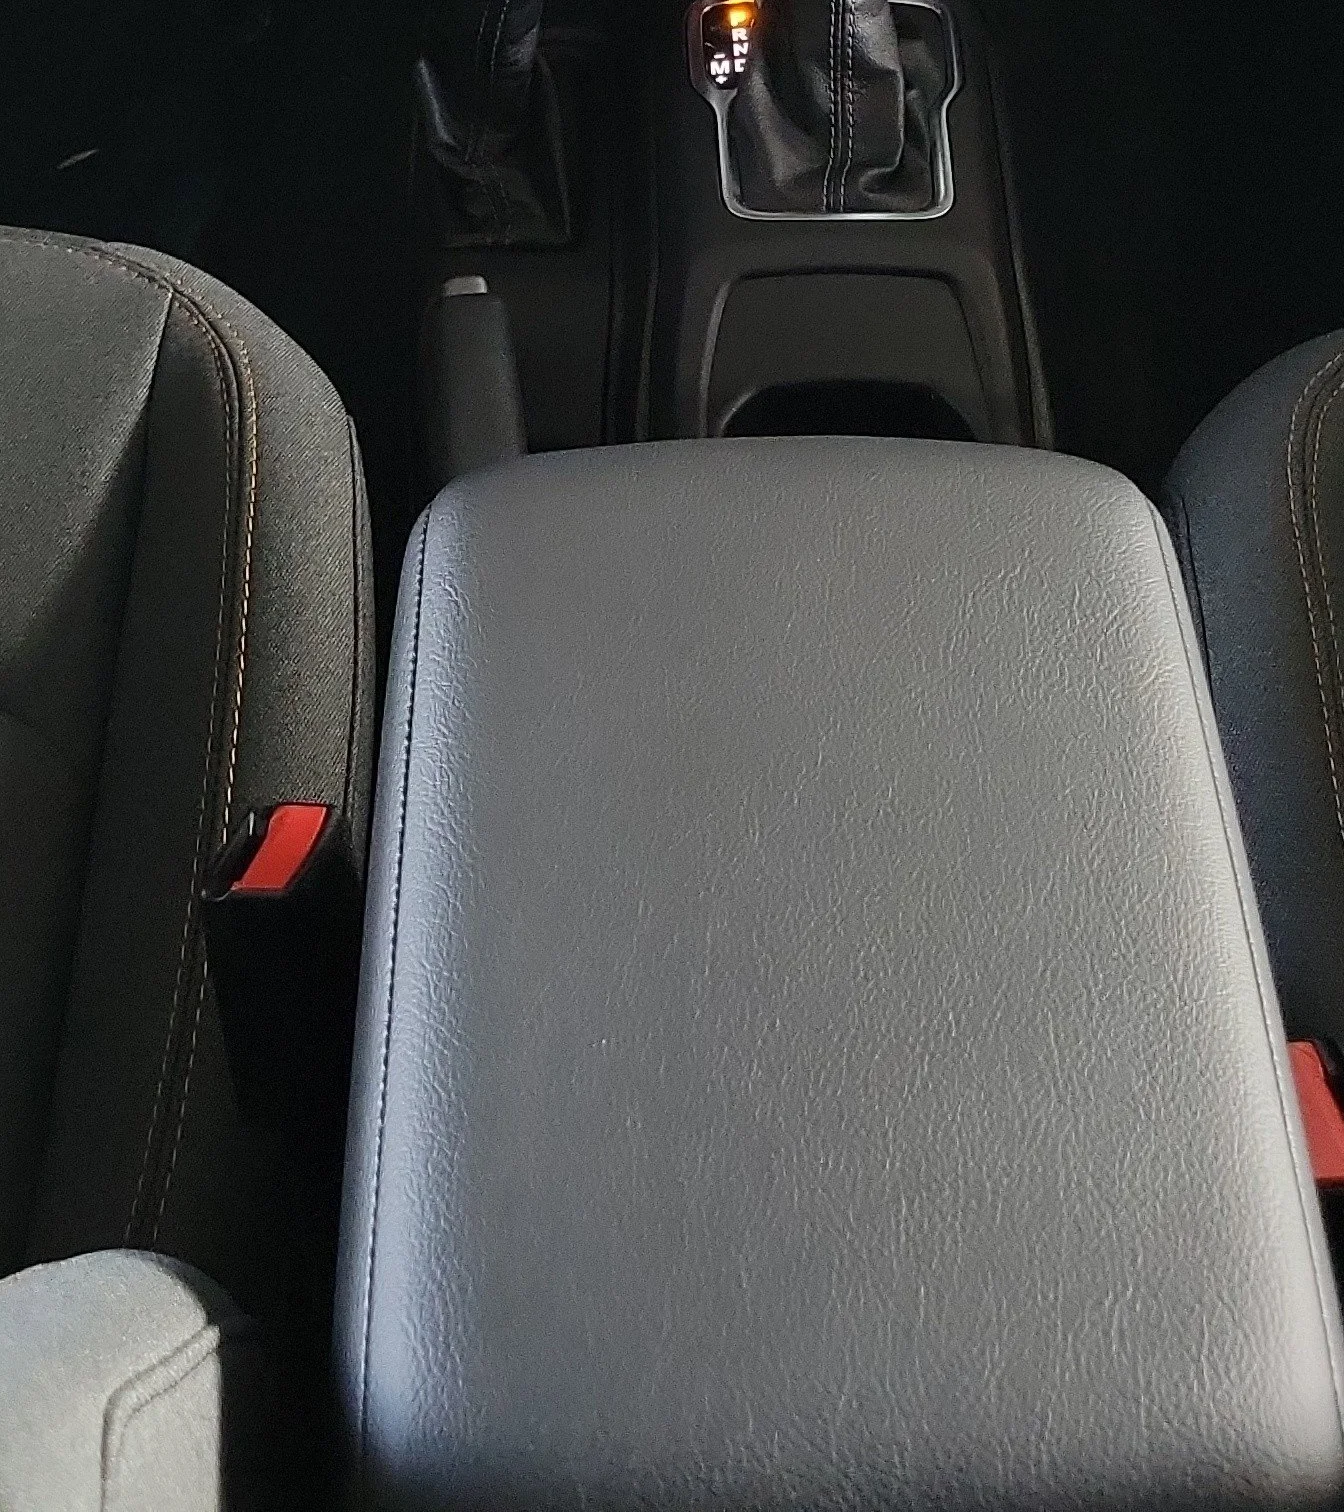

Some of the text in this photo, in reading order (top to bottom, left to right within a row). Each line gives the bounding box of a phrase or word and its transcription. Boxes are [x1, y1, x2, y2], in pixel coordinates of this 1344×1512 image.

[731, 28, 748, 42] R
[733, 42, 749, 57] N
[710, 59, 730, 76] M
